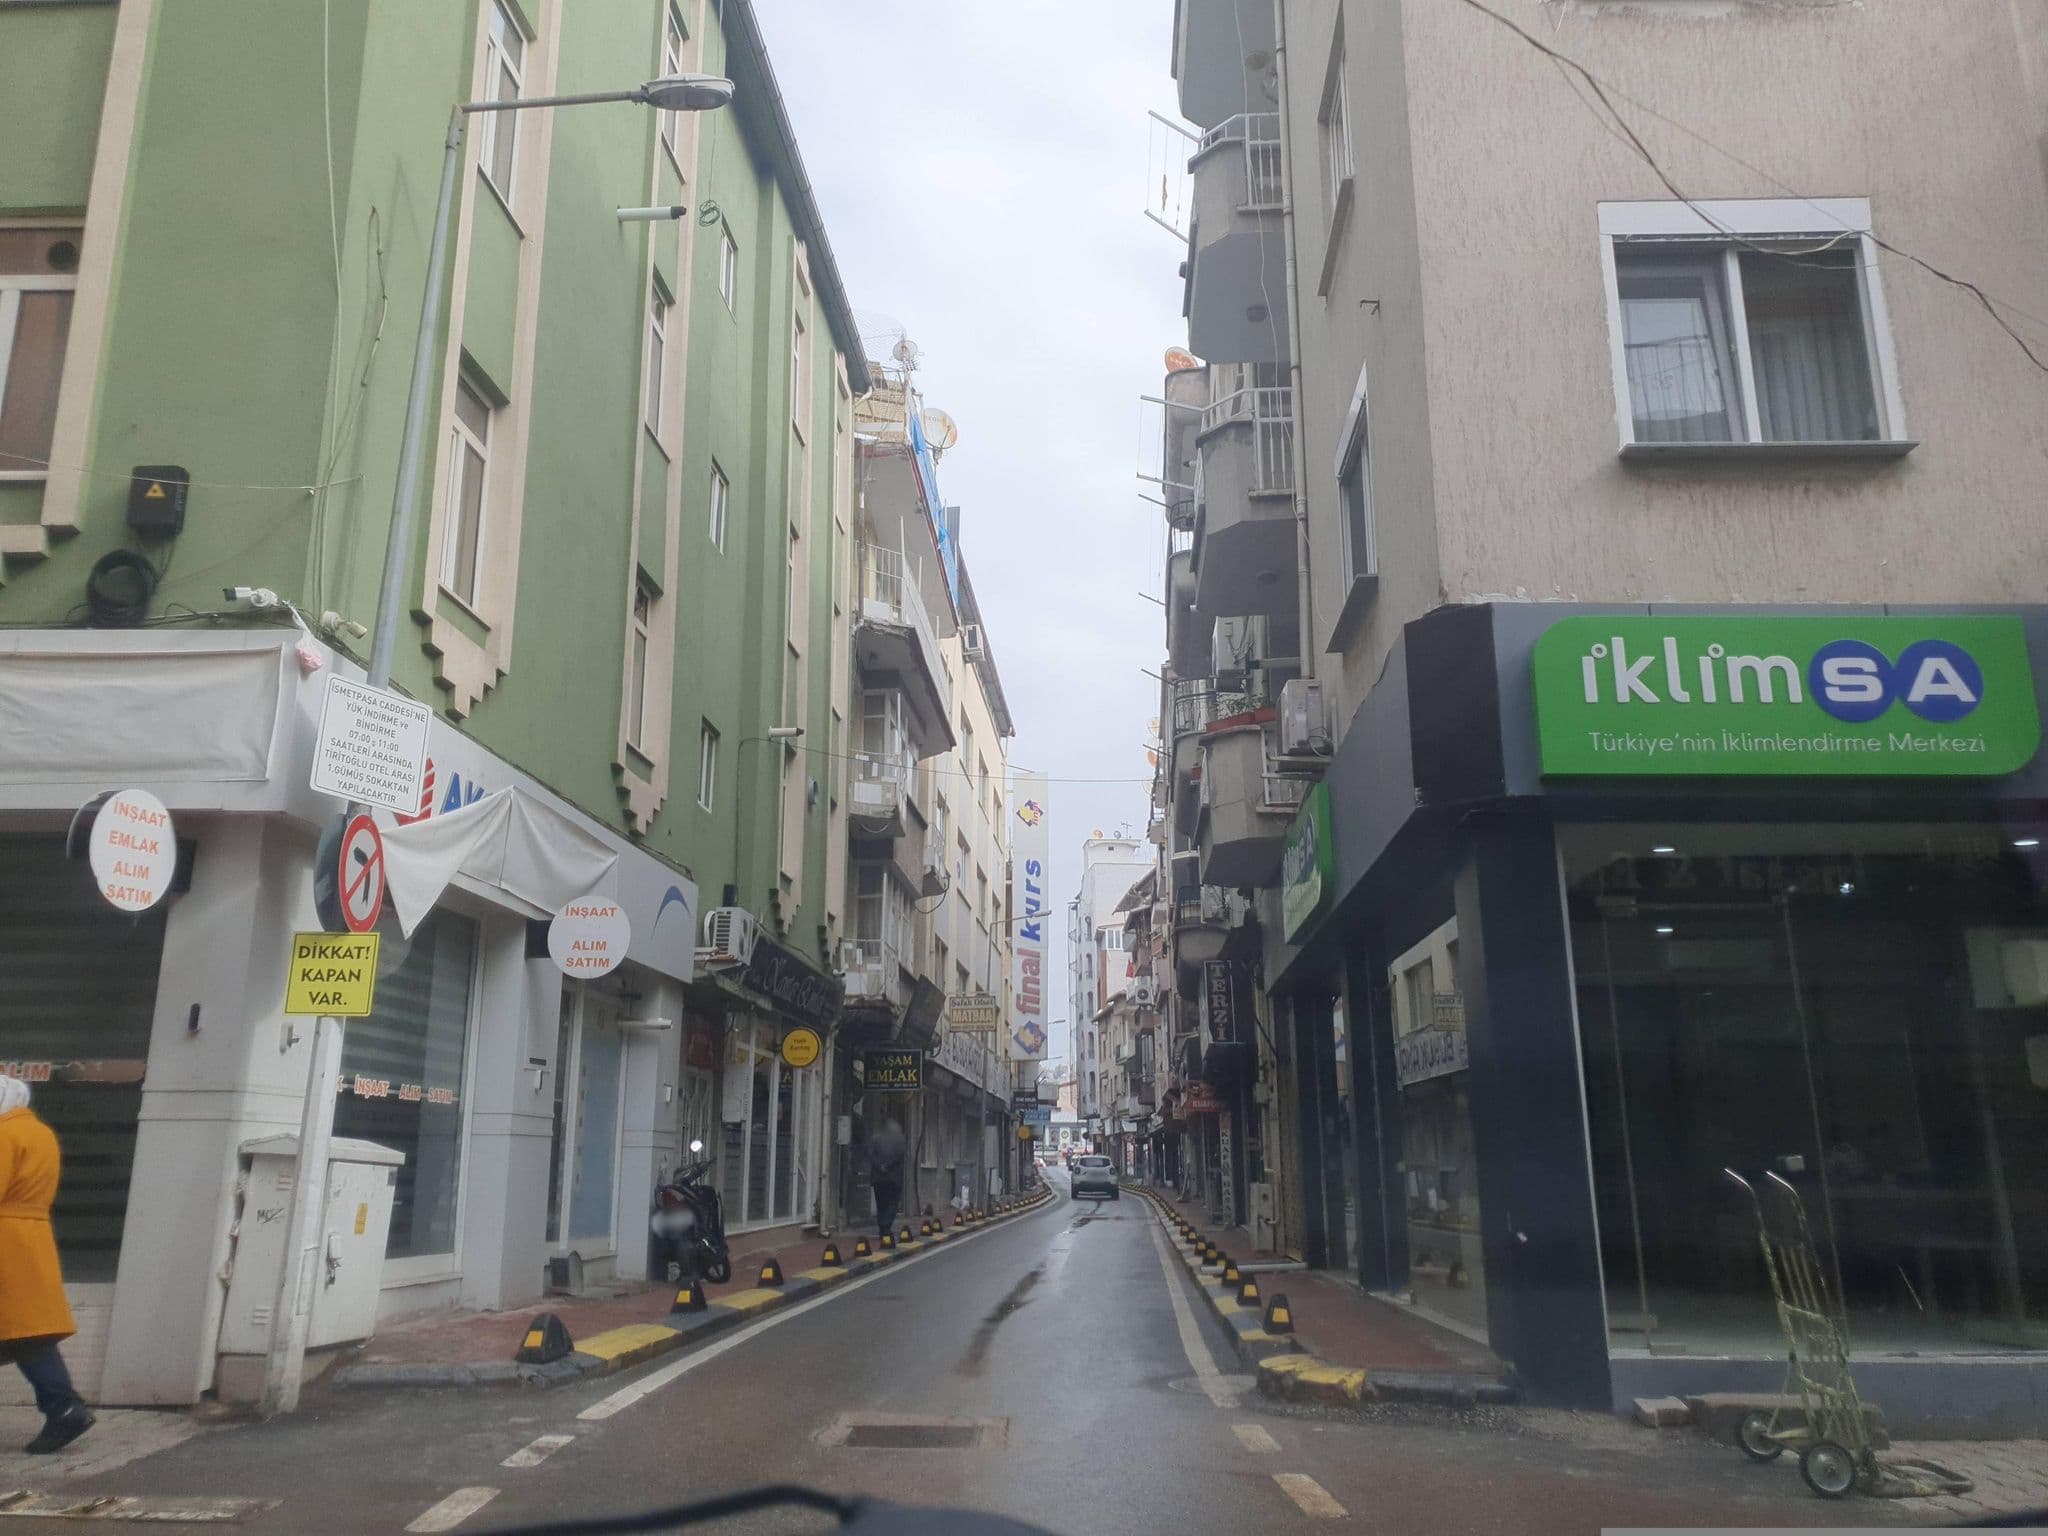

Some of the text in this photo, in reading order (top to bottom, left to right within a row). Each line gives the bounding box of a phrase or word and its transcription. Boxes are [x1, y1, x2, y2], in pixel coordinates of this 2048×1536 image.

[1582, 637, 1977, 703] iklimSA
[346, 702, 364, 715] YÜK
[364, 705, 398, 727] İNDİRME
[355, 719, 397, 738] BİNDİRME
[349, 730, 371, 743] 07:00
[378, 739, 399, 752] 11:00
[1588, 729, 1985, 756] Türkiye'nin İklimlendirme Merkezi
[330, 737, 413, 770] SAATLERİ ARASINDA
[325, 749, 415, 784] TİRİTOĞLU OTEL ARASI
[338, 779, 397, 803] YAPILACAKTIR
[366, 775, 410, 795] SOKAKTAN
[113, 797, 167, 828] İNŞAAT
[108, 831, 160, 855] EMLAK
[113, 861, 150, 880] ALIM
[106, 884, 153, 905] SATIM
[565, 905, 617, 918] İNŞAAT
[572, 940, 607, 951] ALIM
[1016, 859, 1041, 1015] final kurs
[298, 941, 371, 960] DİKKAT!
[566, 957, 610, 968] SATIM
[301, 968, 361, 983] KAPAN
[309, 992, 347, 1005] VAR.
[952, 1008, 994, 1023] MATBAA
[872, 1055, 913, 1068] YAŞAM
[868, 1069, 918, 1082] EMLAK
